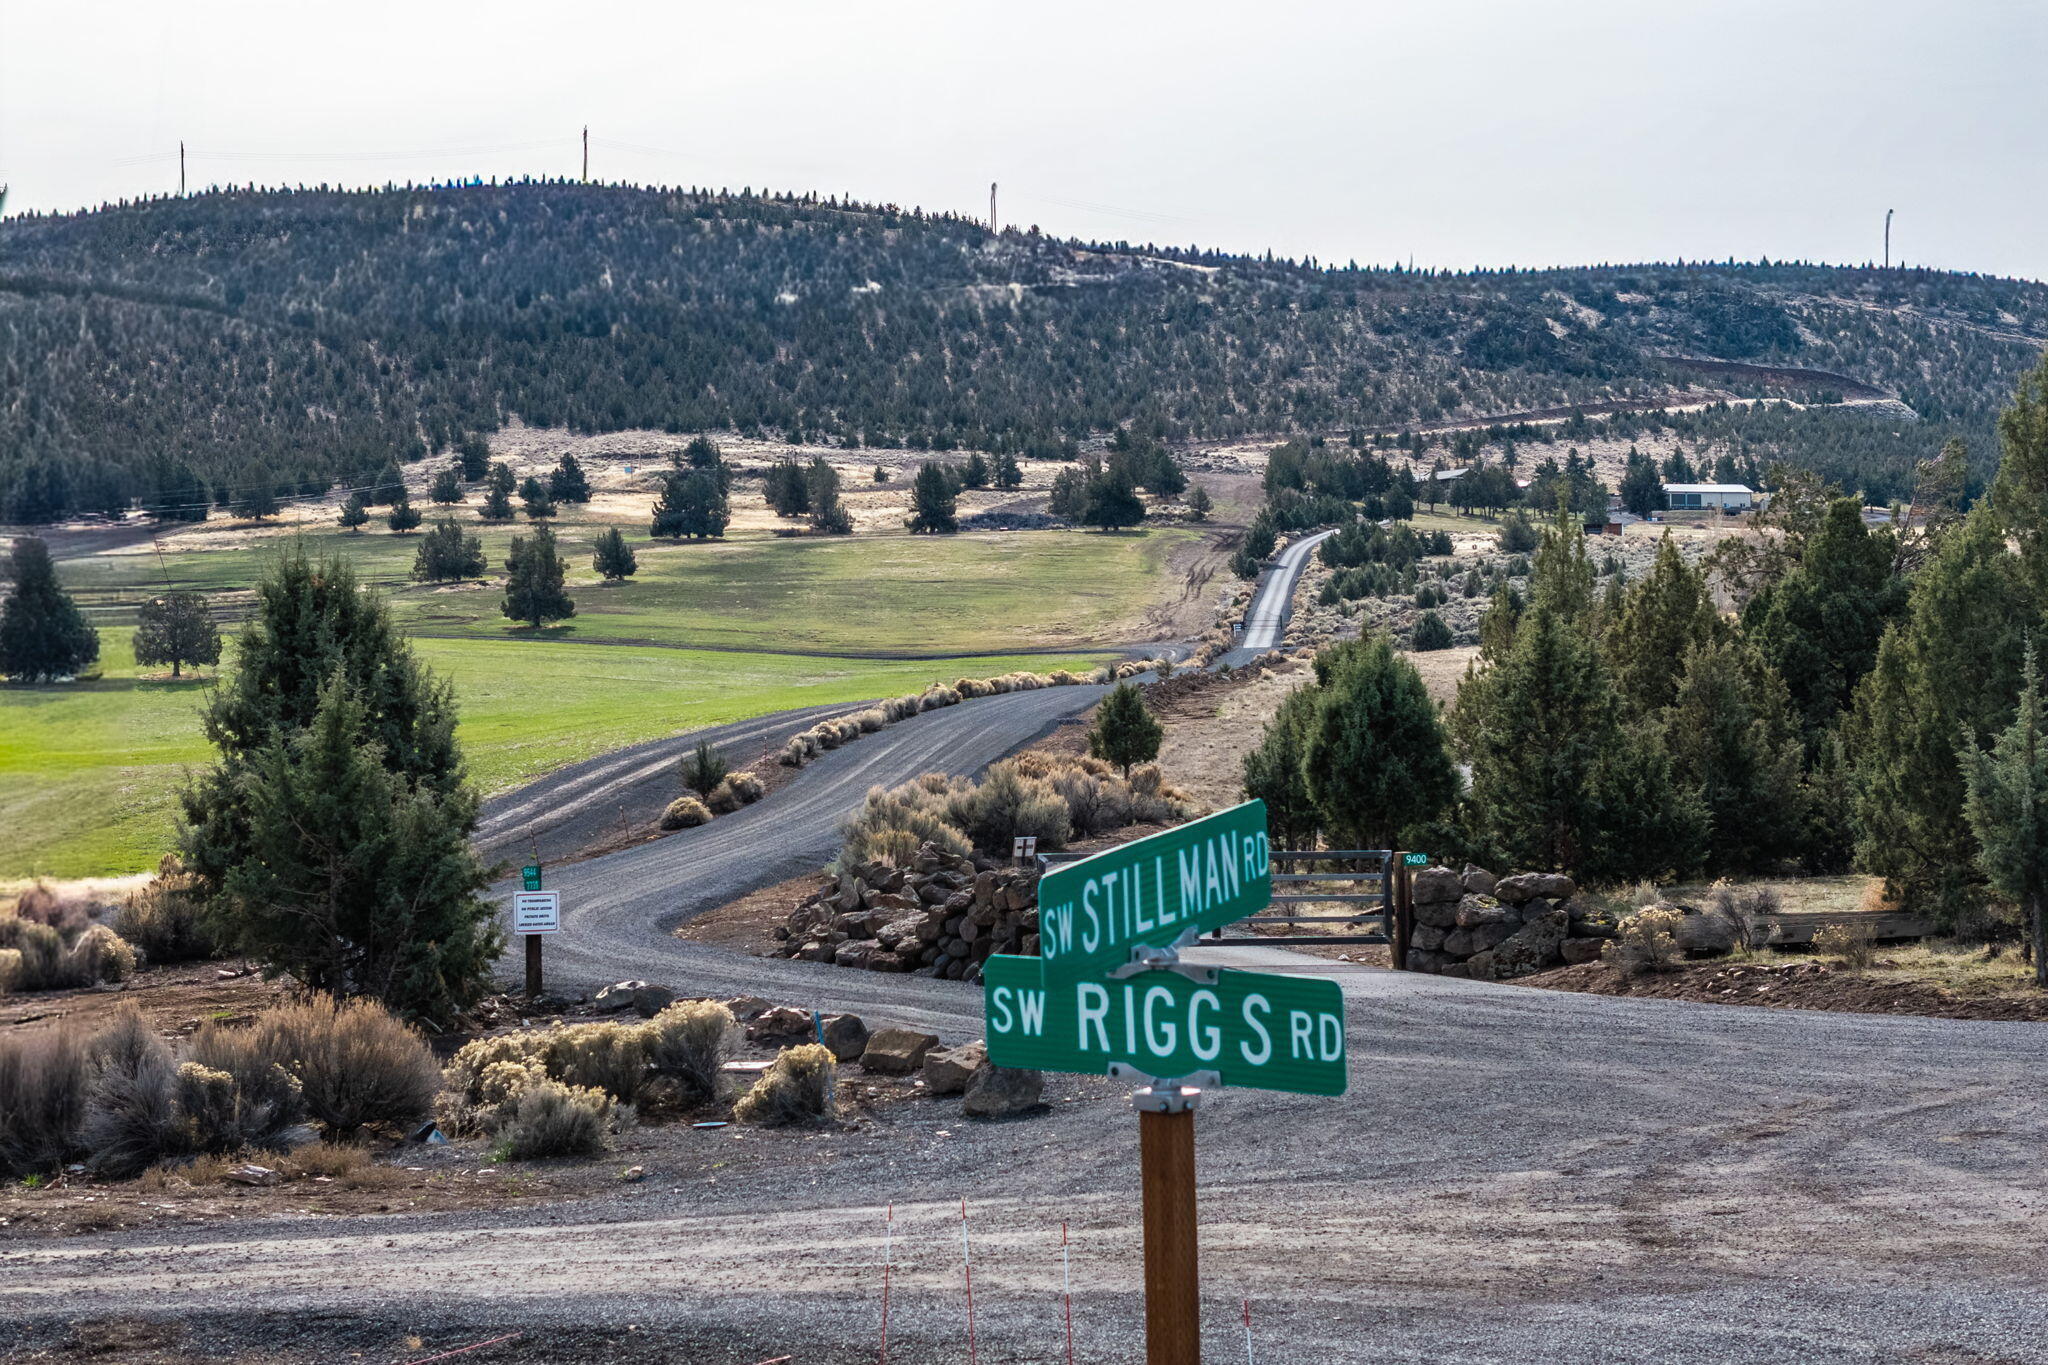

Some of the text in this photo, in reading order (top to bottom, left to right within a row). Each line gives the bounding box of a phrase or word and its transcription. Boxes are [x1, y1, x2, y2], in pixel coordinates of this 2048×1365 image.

[1044, 830, 1269, 960] SW STILLMAN RD
[1405, 854, 1427, 864] 9400
[992, 982, 1343, 1066] SW RIGGS RD
